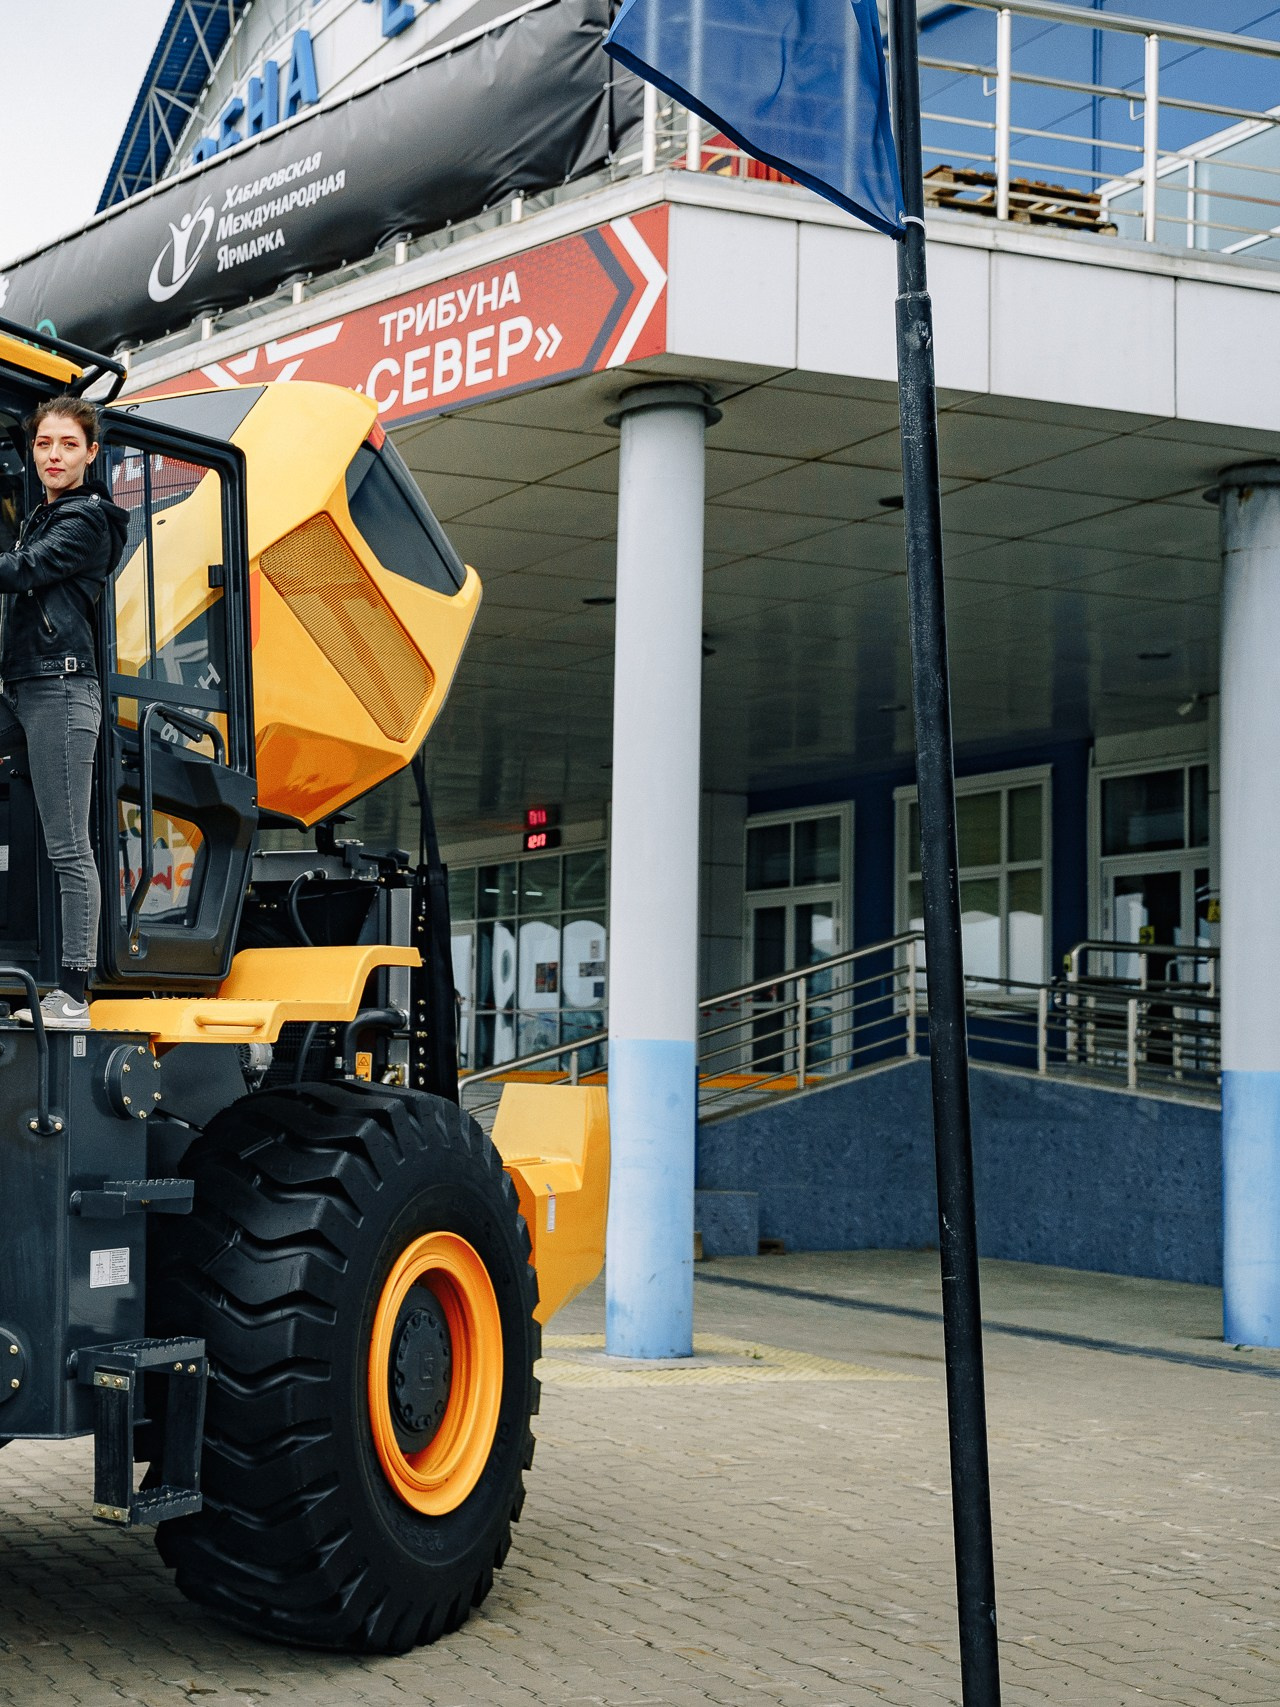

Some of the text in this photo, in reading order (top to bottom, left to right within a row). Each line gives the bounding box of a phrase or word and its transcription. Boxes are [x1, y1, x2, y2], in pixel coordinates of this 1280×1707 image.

[192, 29, 319, 165] ЕНА
[216, 169, 346, 242] МЕЖДУНАРОДНАЯ
[221, 151, 322, 212] ХАБАРОВСКАЯ
[216, 228, 285, 273] ЯРМАРКА
[378, 270, 521, 346] ТРИБУНА
